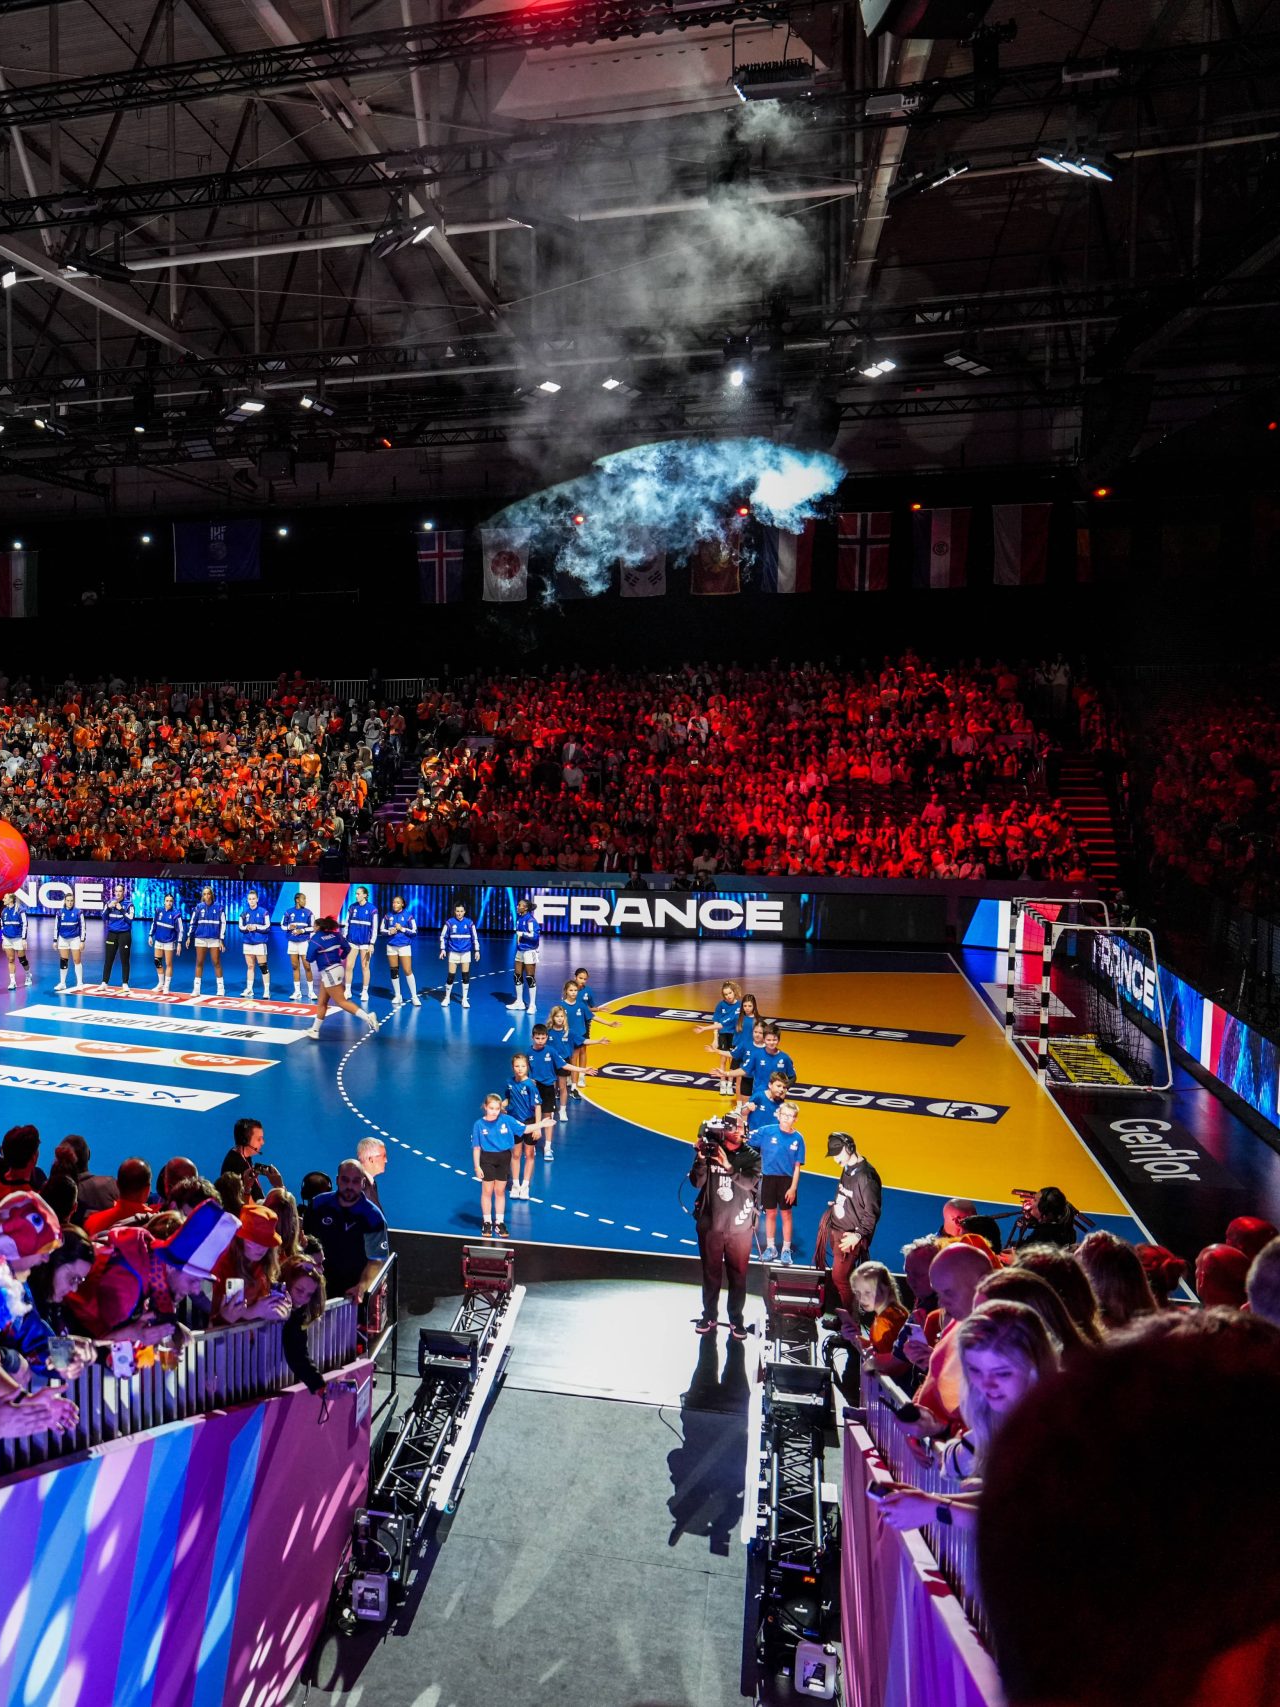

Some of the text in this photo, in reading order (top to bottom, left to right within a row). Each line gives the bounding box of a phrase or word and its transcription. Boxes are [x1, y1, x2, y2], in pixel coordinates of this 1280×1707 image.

[533, 895, 784, 931] FRANCE
[1093, 933, 1156, 1012] FRANCE
[209, 998, 312, 1015] Gitem
[657, 1009, 889, 1038] Berus
[80, 1042, 132, 1053] MOL
[187, 1054, 241, 1065] MOL
[602, 1065, 915, 1109] Gjendige
[1109, 1118, 1201, 1182] Gerflor
